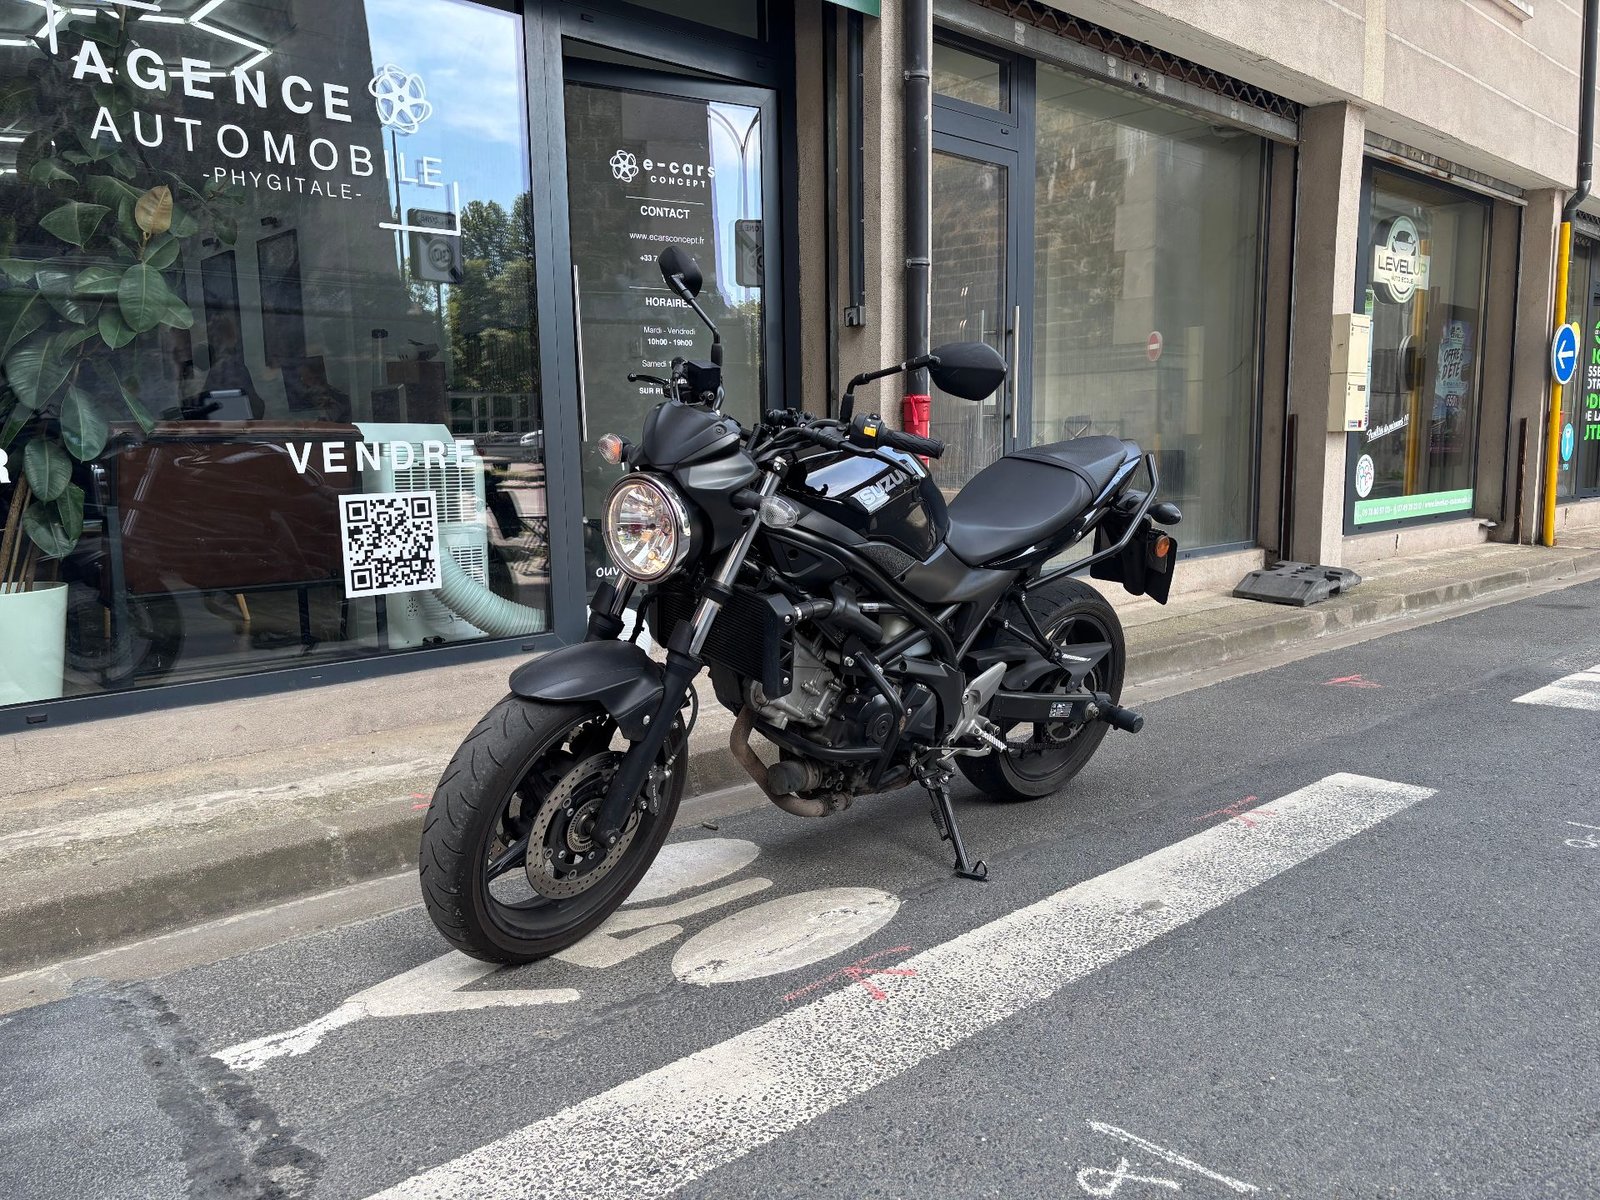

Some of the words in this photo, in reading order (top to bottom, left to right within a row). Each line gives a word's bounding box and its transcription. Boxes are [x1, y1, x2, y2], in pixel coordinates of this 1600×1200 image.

[72, 40, 353, 123] AGENCE
[90, 106, 444, 188] AUTOMOBILE
[643, 158, 716, 178] e-cars
[650, 175, 706, 189] CONCEPT
[640, 205, 690, 219] CONTACT
[629, 232, 705, 245] www.ecarsconcept.fr
[640, 254, 652, 262] +33
[643, 326, 662, 334] Mardi
[667, 327, 696, 335] Vendredi
[647, 338, 668, 346] 10h00
[673, 339, 693, 347] 19h00
[641, 359, 667, 368] Samedi
[639, 387, 654, 395] SUR
[286, 440, 476, 474] VENDRE
